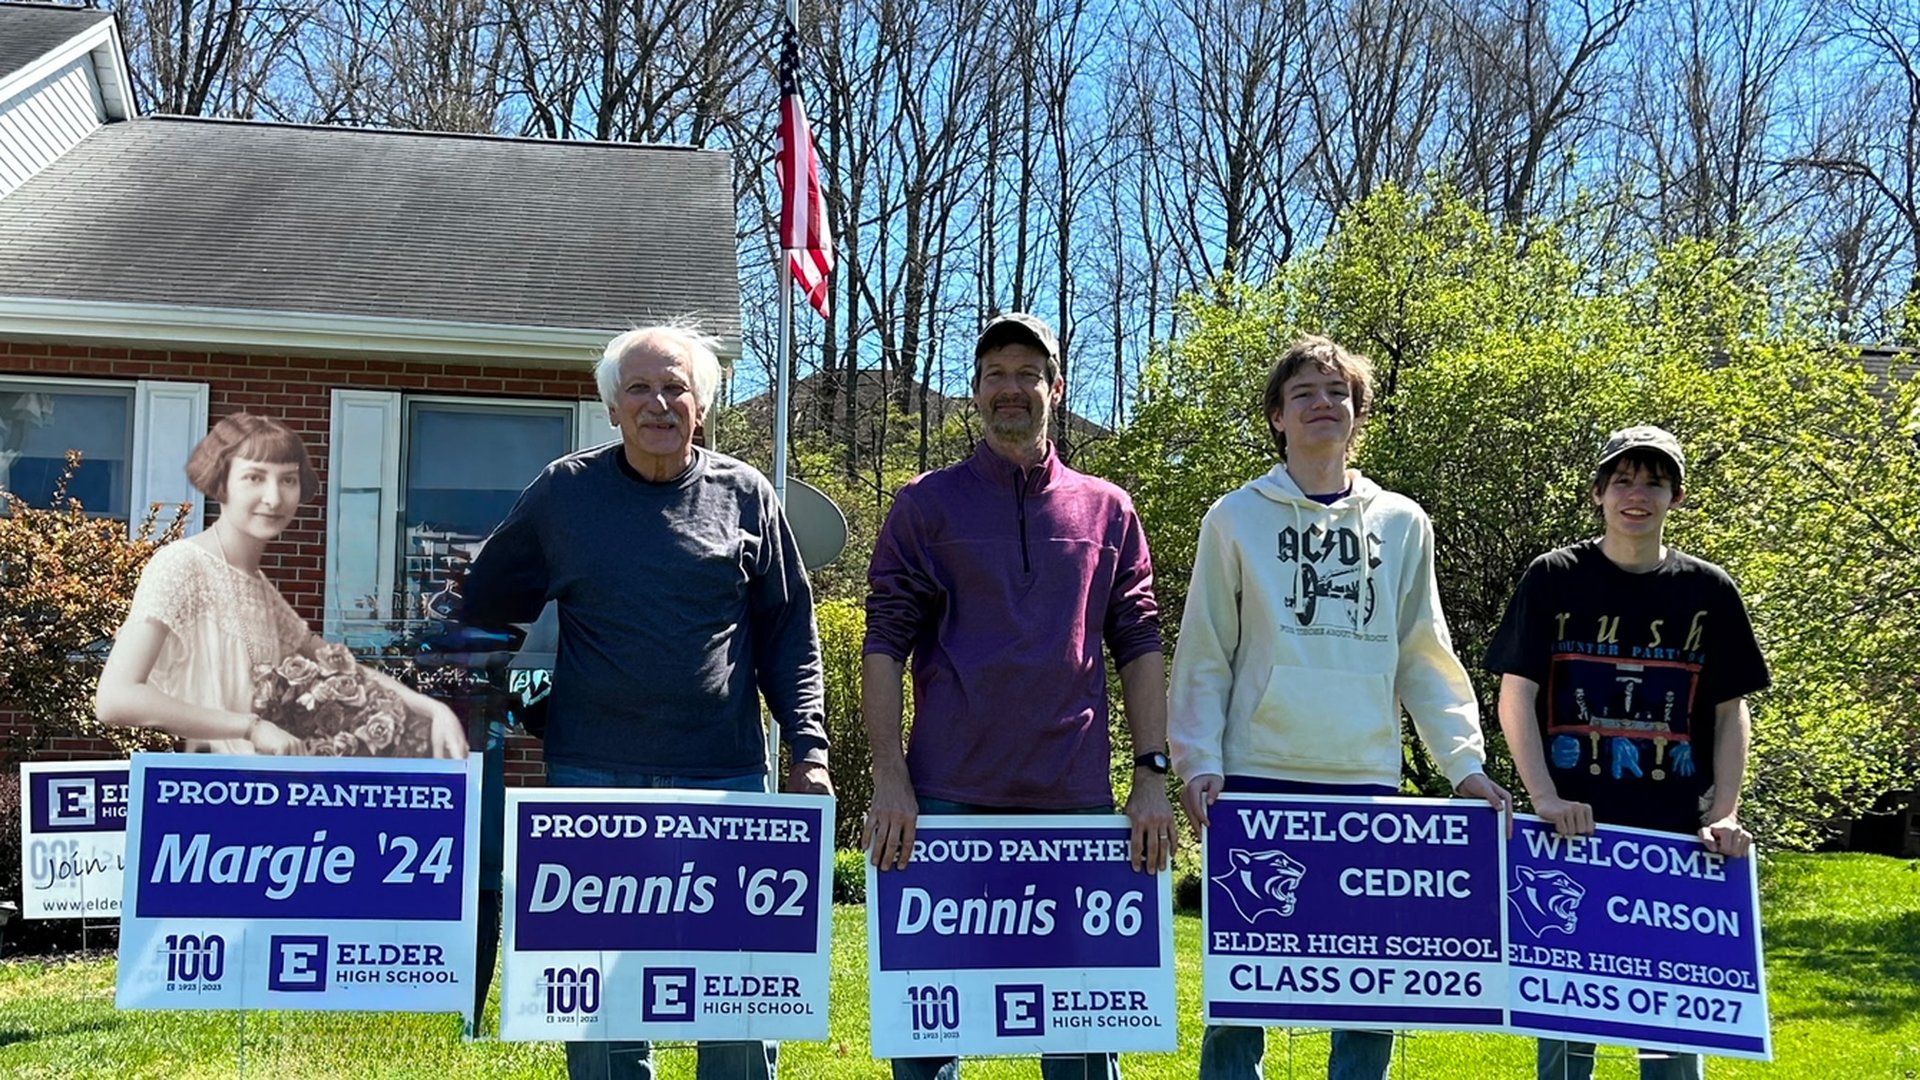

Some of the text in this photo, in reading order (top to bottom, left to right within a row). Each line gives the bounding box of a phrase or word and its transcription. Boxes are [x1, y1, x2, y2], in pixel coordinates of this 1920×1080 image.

[1555, 611, 1708, 651] rush
[157, 780, 454, 810] PROUD PANTHER
[530, 814, 811, 843] PROUD PANTHER
[1237, 809, 1469, 845] WELCOME
[150, 830, 454, 900] Margie '24
[894, 840, 993, 862] ROUD
[1522, 828, 1726, 882] WELCOME
[528, 861, 809, 917] Dennis '62
[1339, 867, 1471, 898] CEDRIC
[896, 884, 1144, 937] Dennis '86
[1606, 896, 1740, 937] CARSON
[165, 934, 225, 982] 100
[337, 943, 445, 966] ELDER
[1213, 931, 1498, 959] ELDER HIGH SCHOOL
[337, 968, 459, 984] HIGH SCHOOL
[1229, 964, 1483, 997] CLASS OF 2026
[1508, 943, 1756, 989] ELDER HIGH SCHOOL
[544, 967, 600, 1014] 100
[703, 976, 801, 998] ELDER
[1052, 991, 1149, 1012] ELDER
[1519, 976, 1743, 1025] CLASS OF 2027
[703, 1002, 814, 1015] HIGH SCHOOL
[908, 985, 960, 1030] 100
[1053, 1015, 1162, 1028] HIGH SCHOOL
